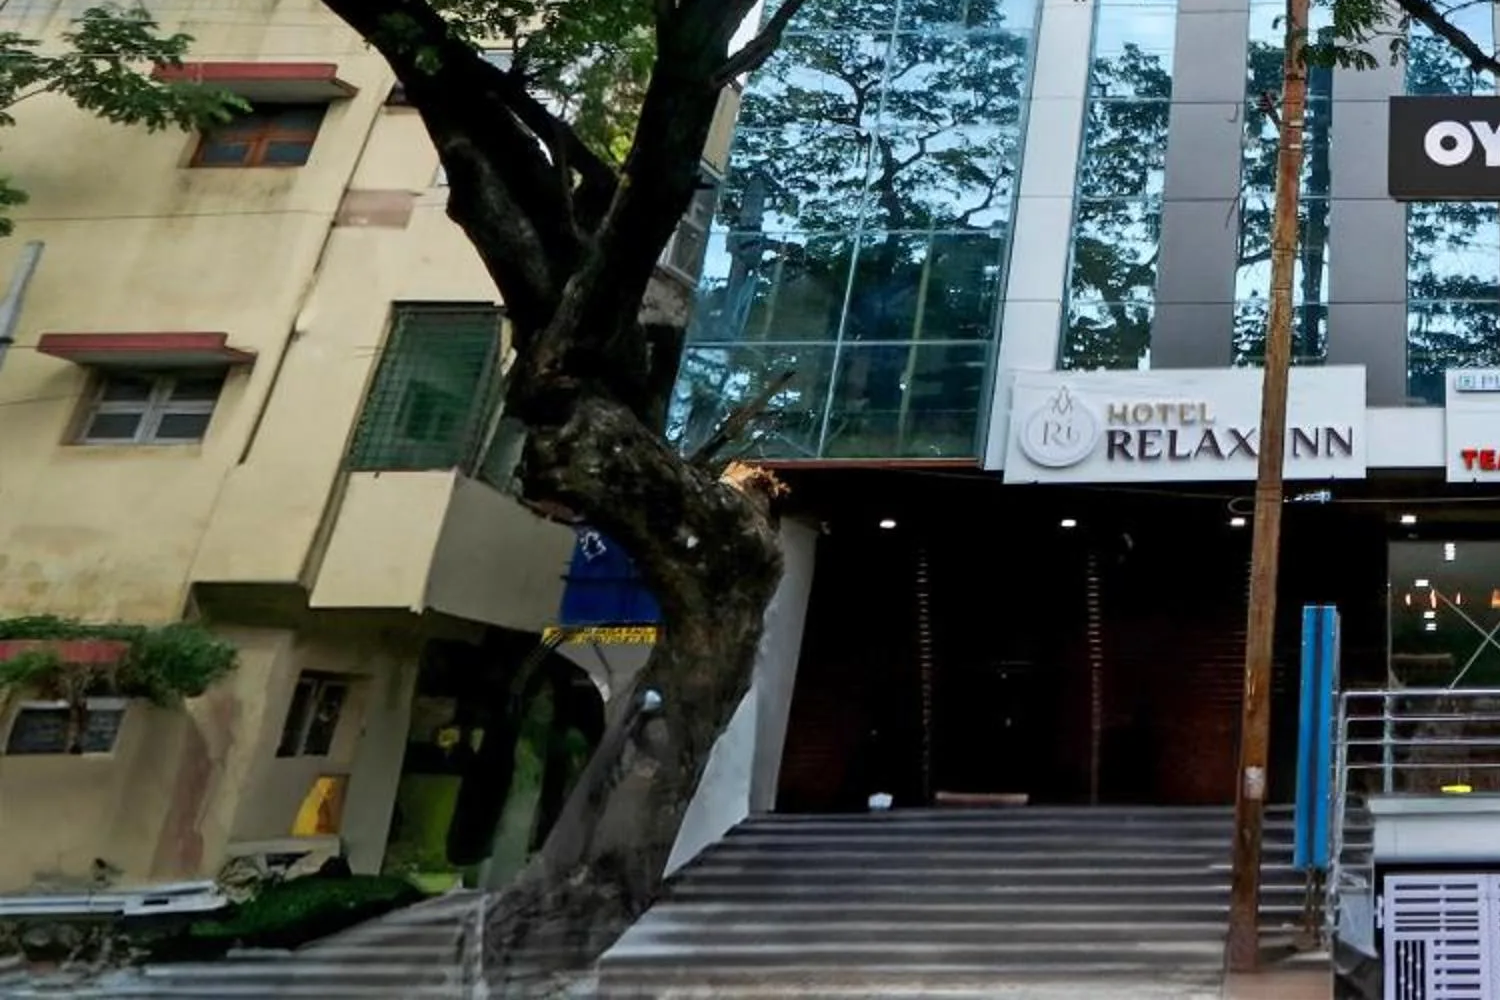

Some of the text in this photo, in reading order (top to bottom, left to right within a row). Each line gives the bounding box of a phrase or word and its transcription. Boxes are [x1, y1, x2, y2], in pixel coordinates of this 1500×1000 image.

[1107, 402, 1217, 426] HOTEL
[1105, 426, 1354, 461] RELAX NN
